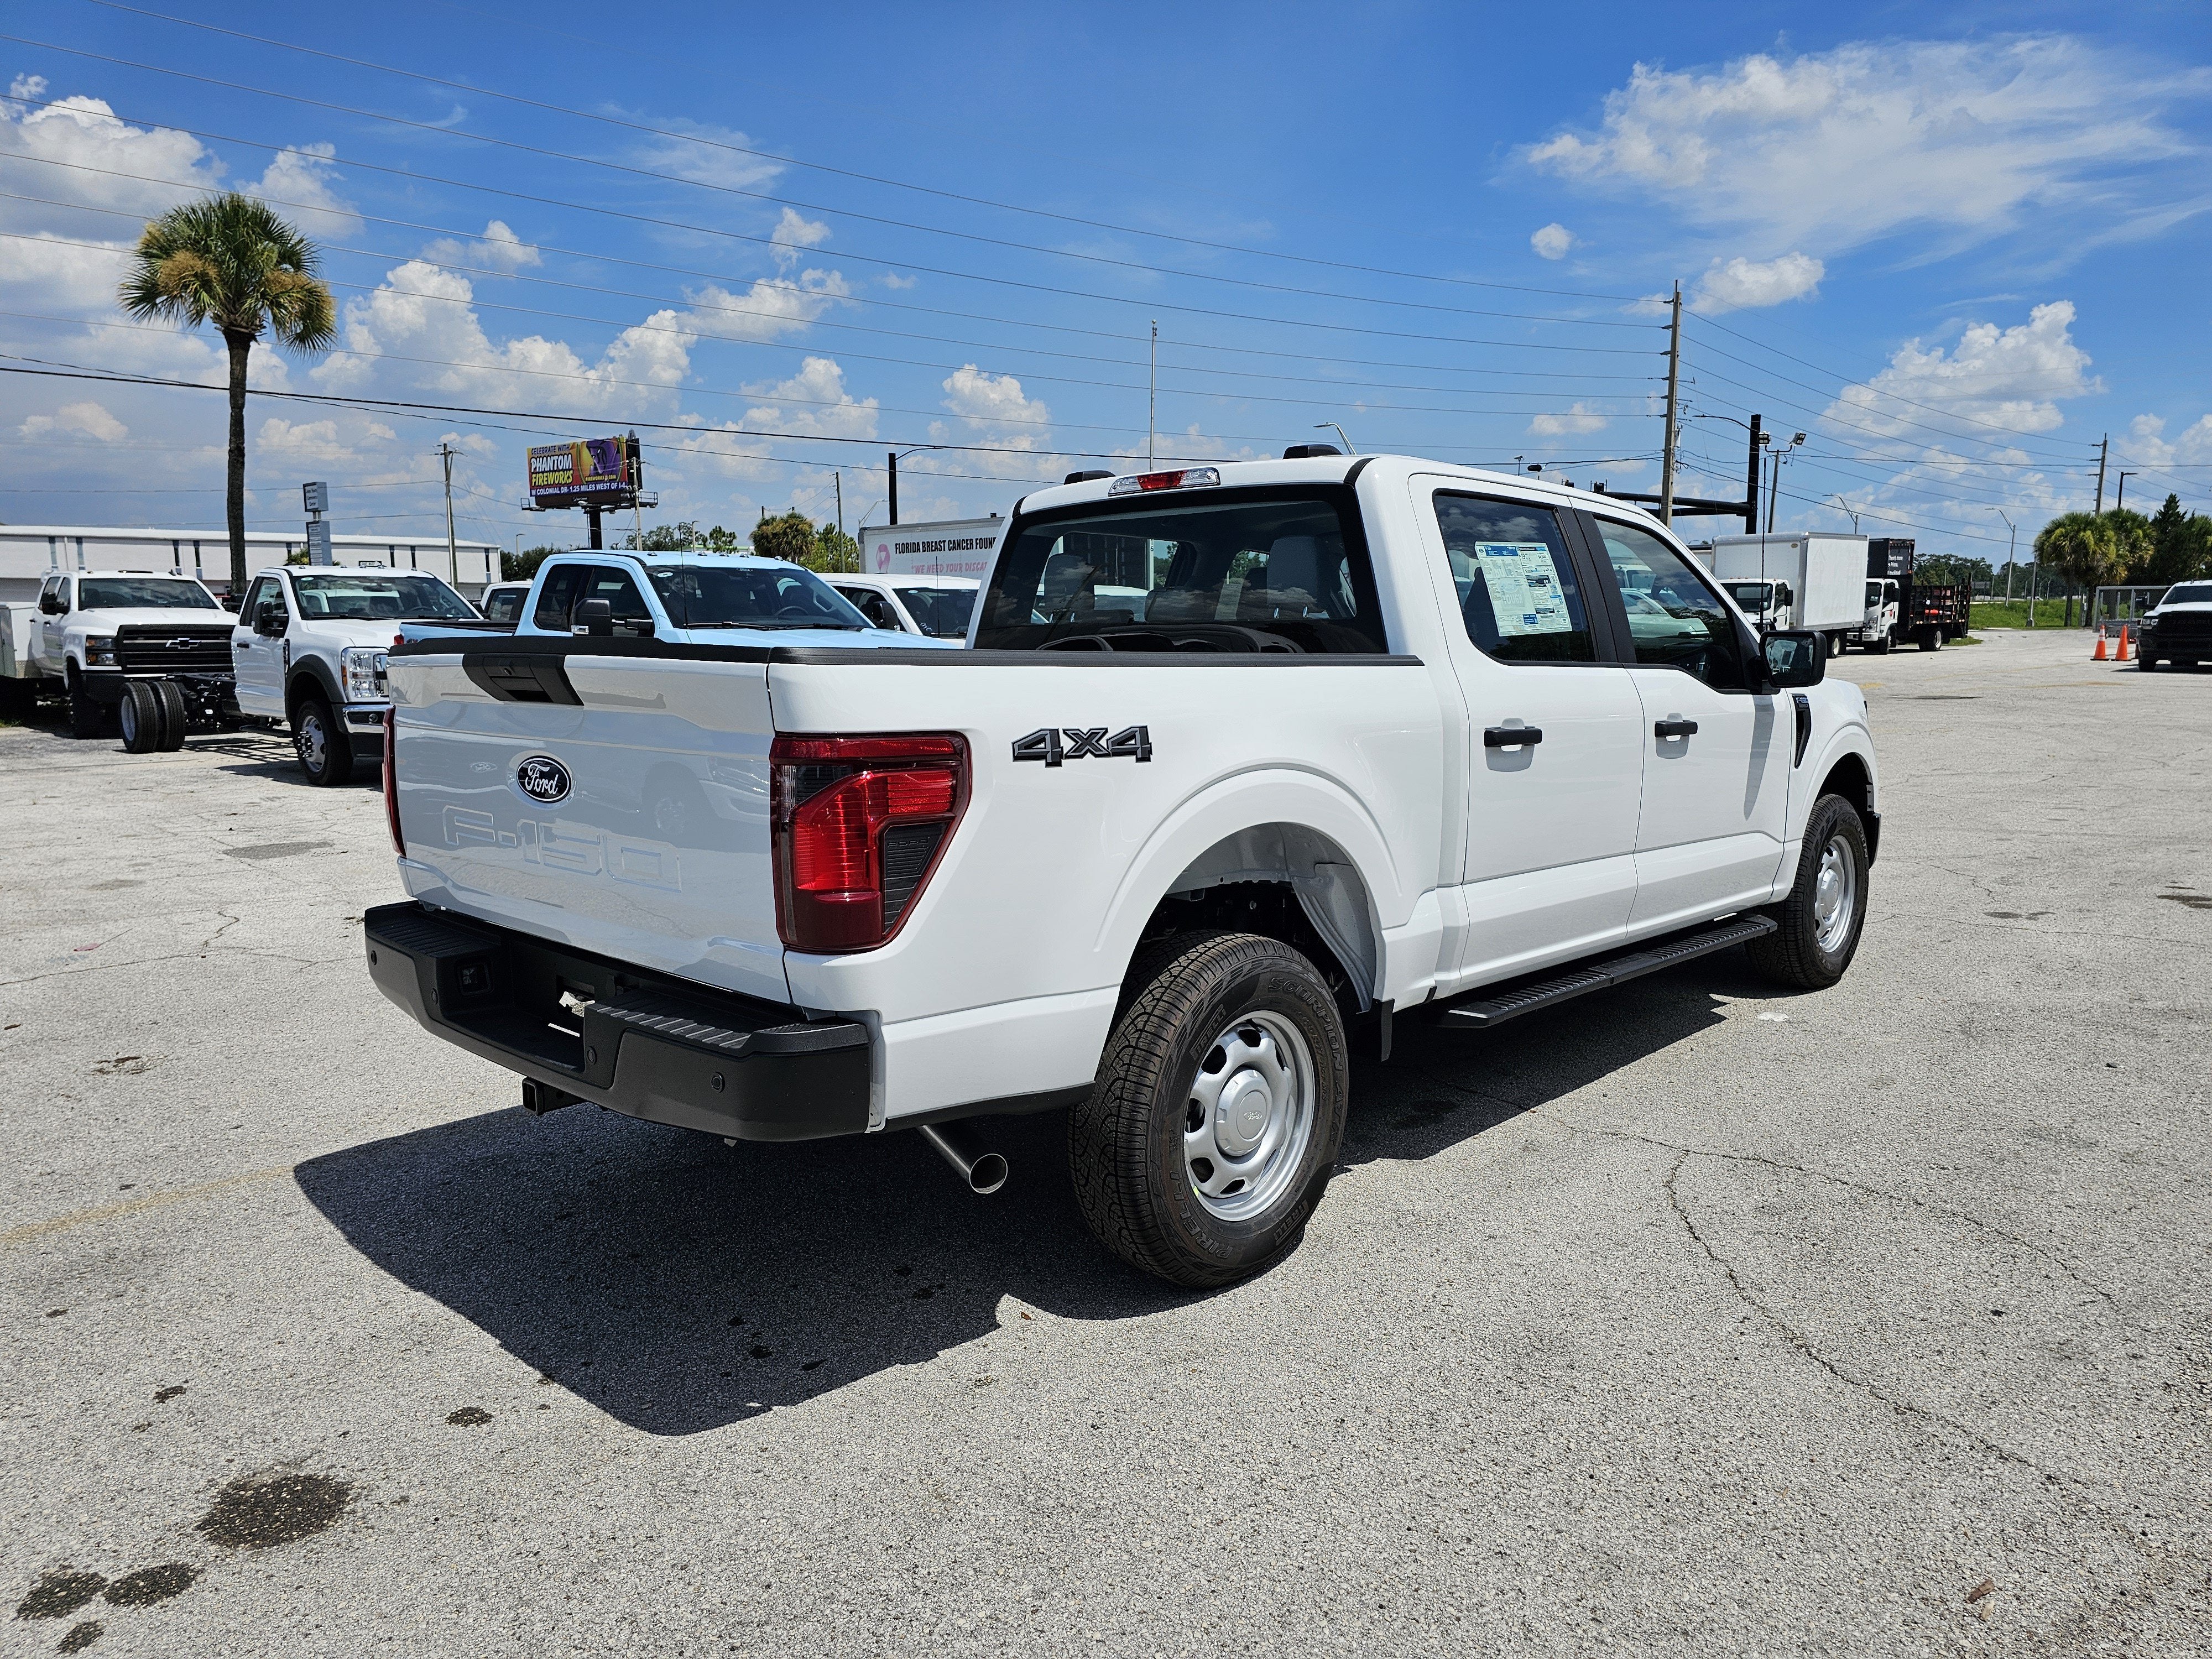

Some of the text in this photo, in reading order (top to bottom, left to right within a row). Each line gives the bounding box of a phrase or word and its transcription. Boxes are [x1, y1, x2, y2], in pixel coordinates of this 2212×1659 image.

[530, 453, 572, 473] PHANTOM
[531, 445, 556, 455] CELEBRATE
[531, 469, 573, 486] FIREWORKS
[895, 541, 921, 554] FLORIDA
[922, 540, 946, 552] BREAST
[947, 538, 974, 551] CANCER
[926, 563, 944, 573] NEED
[946, 562, 962, 573] YOUR
[524, 763, 559, 796] Ford
[442, 805, 682, 894] F-150
[1189, 1004, 1227, 1062] PIRELLI
[1268, 977, 1344, 1072] SCORPION
[1169, 1171, 1233, 1259] PIRELLI
